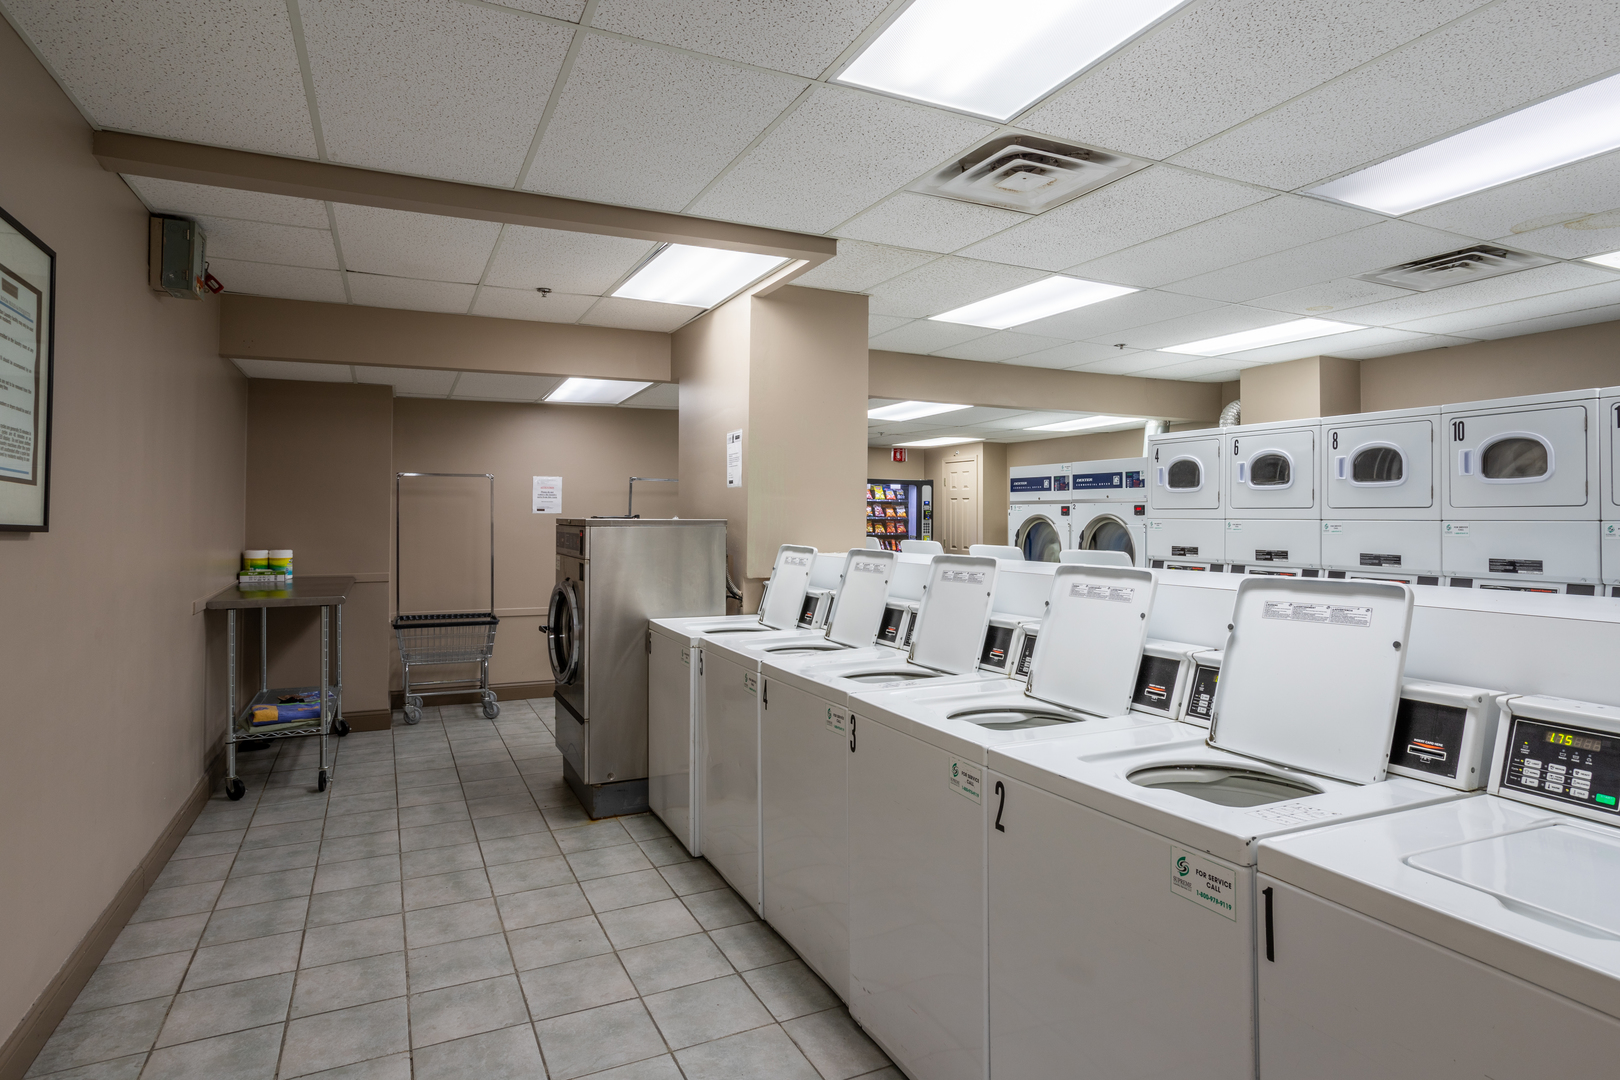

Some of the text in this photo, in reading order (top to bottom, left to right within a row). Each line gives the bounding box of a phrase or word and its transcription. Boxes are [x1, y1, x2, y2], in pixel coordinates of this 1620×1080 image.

[1332, 432, 1338, 450] 8
[1452, 421, 1465, 442] 10
[1154, 448, 1160, 462] 4
[1234, 440, 1239, 456] 6
[763, 679, 768, 710] 4
[850, 714, 856, 752] 3
[1550, 732, 1573, 746] 1.75
[994, 781, 1005, 832] 2
[1196, 868, 1206, 879] FOR
[1208, 874, 1232, 890] SERVICE
[1206, 882, 1221, 893] CALL
[1262, 886, 1274, 962] 1
